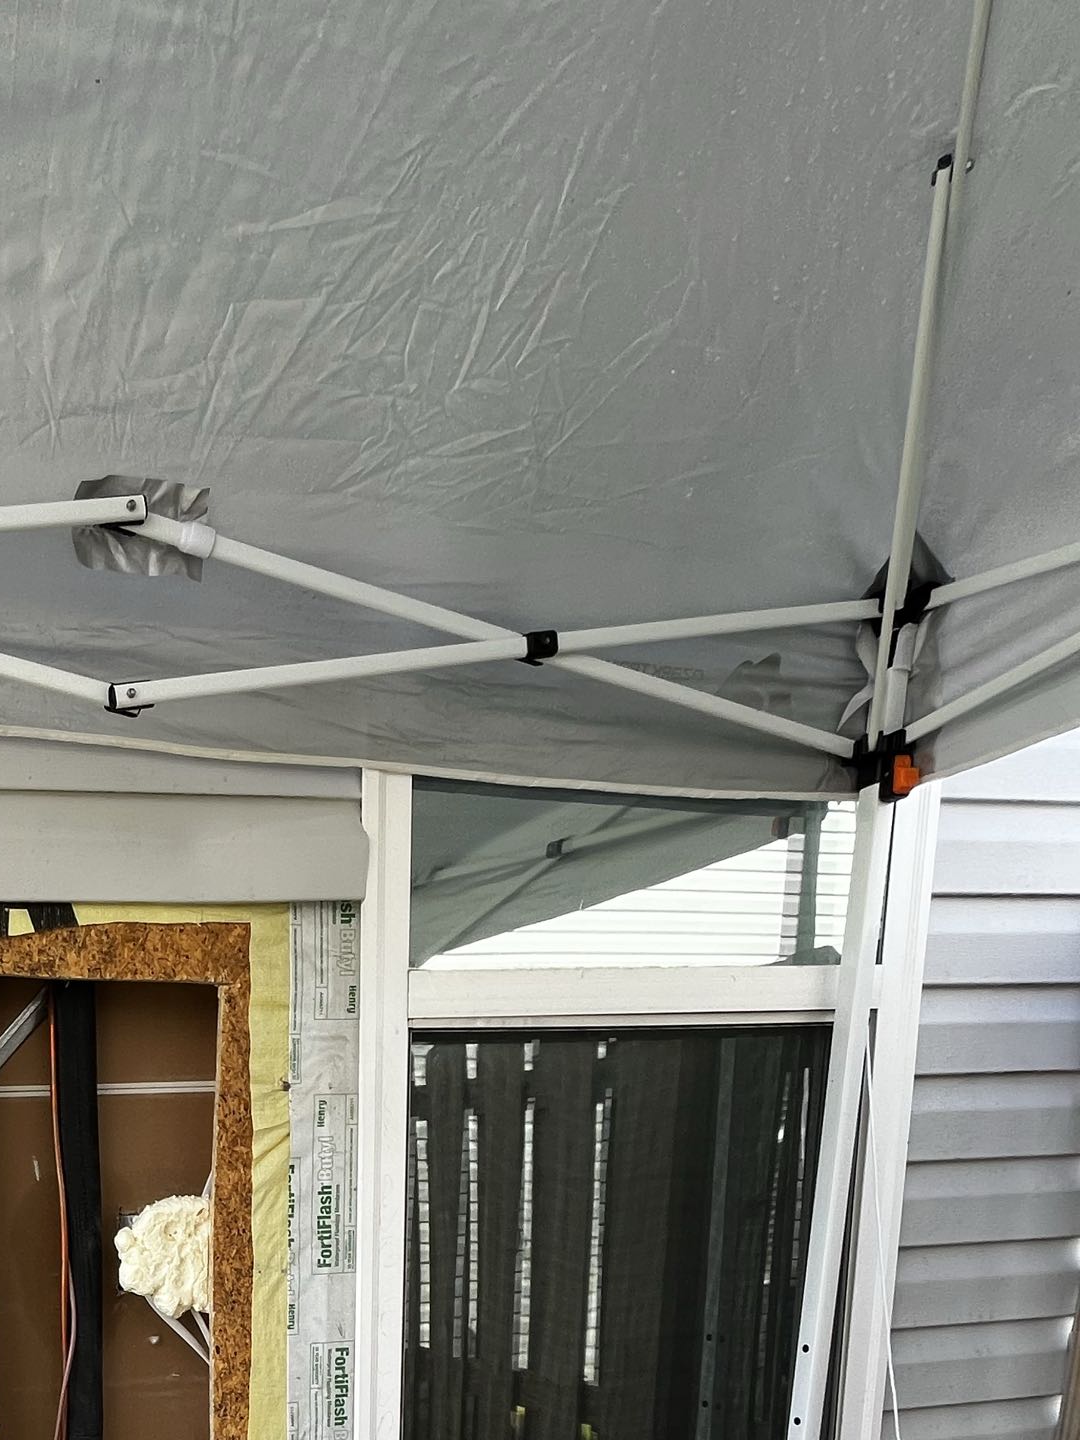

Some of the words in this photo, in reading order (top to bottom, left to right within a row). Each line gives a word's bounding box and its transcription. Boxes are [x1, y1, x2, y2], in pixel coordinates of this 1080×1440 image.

[336, 929, 357, 976] Butyl
[347, 985, 357, 1014] Henry
[316, 1100, 328, 1127] Henry
[317, 1136, 336, 1181] Butyl
[317, 1184, 332, 1268] FortiFlash
[287, 1304, 295, 1330] Henry
[334, 1347, 350, 1426] FortiFlash
